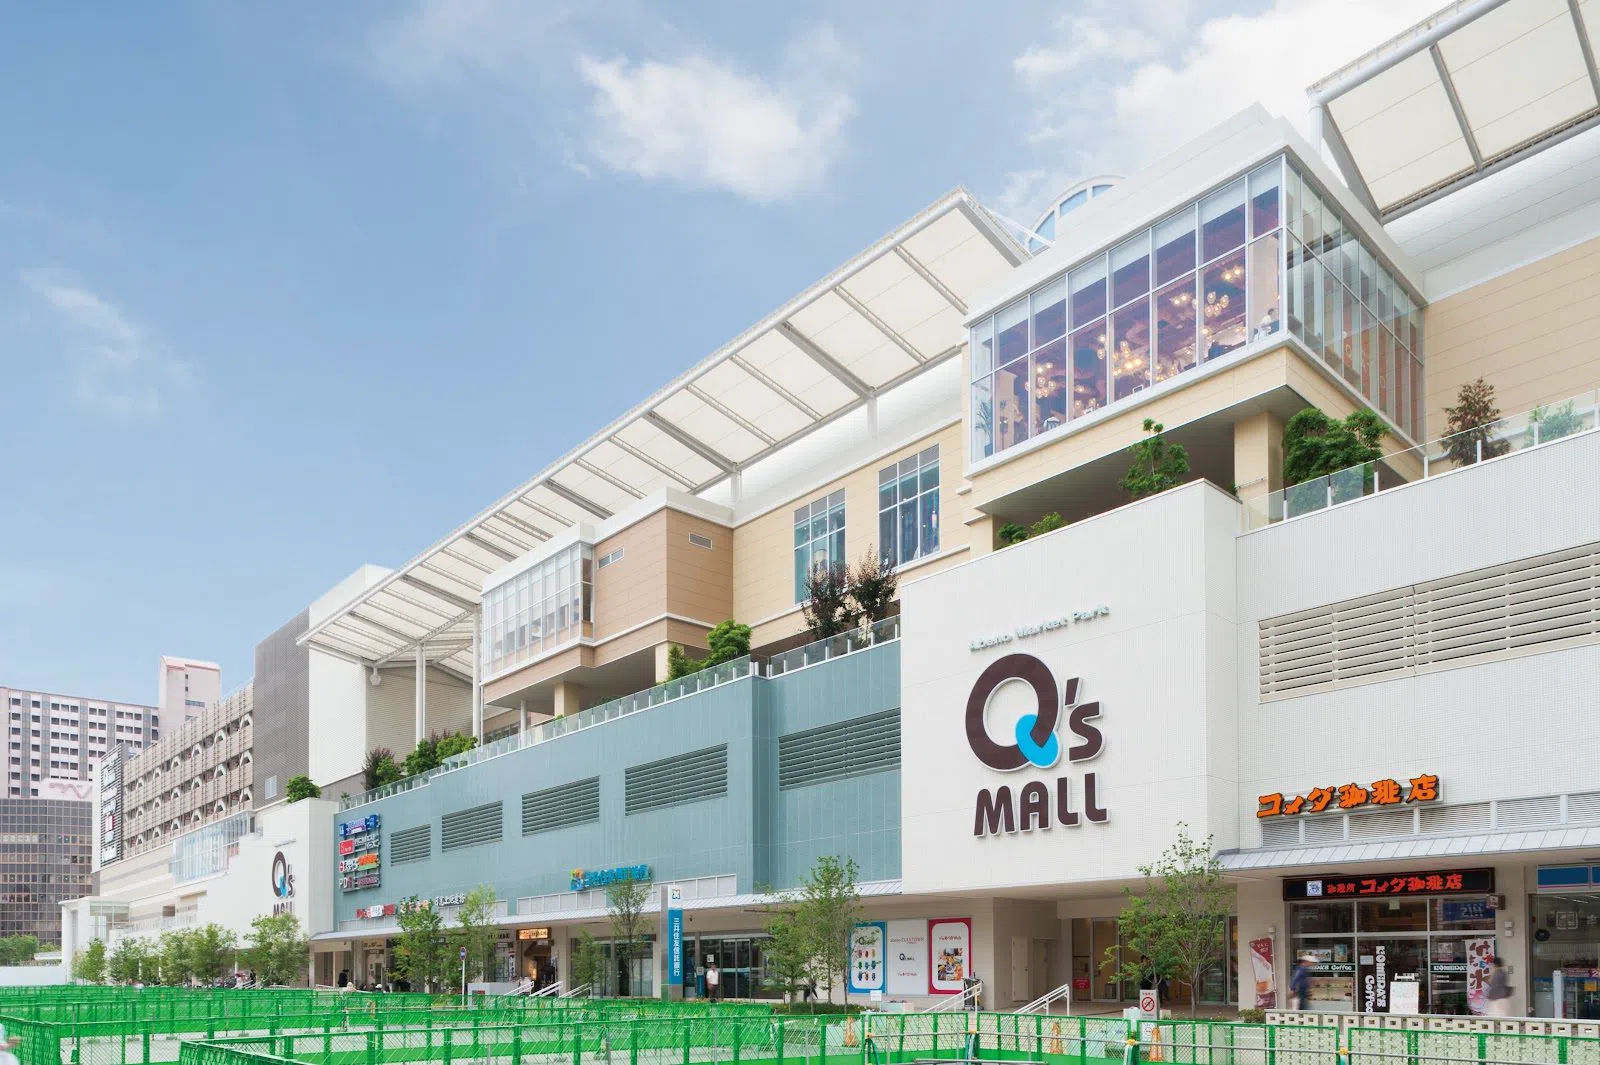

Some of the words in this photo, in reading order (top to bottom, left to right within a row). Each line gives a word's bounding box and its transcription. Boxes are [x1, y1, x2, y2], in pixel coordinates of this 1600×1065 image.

[1072, 604, 1110, 625] Park
[965, 653, 1105, 771] Q's
[973, 772, 1109, 837] MALL
[1256, 773, 1440, 819] コメダ珈琲店
[1359, 873, 1463, 894] コメダ珈琲店
[1375, 945, 1387, 1008] KOMEDA'S
